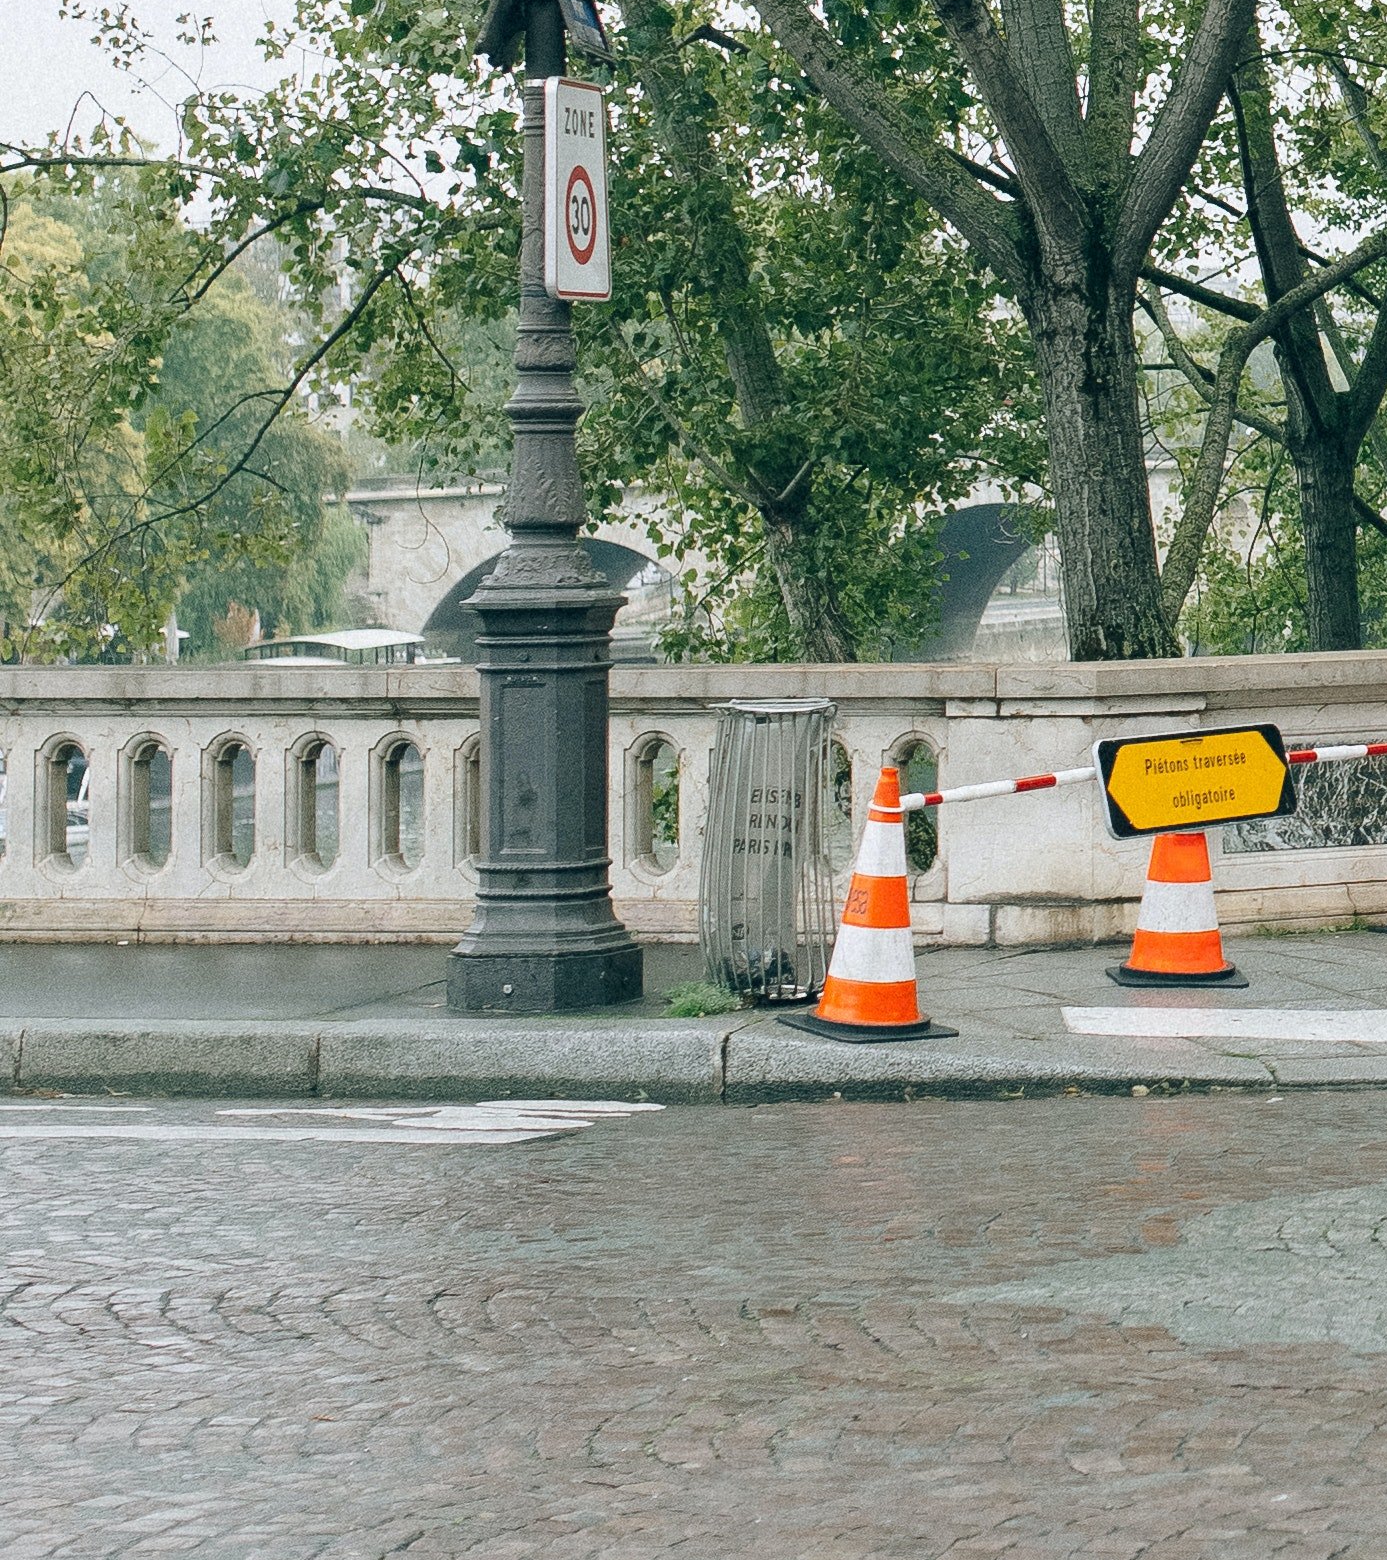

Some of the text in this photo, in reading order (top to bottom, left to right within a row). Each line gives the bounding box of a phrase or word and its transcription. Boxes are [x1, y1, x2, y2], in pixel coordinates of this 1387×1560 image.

[563, 106, 595, 139] ZONE
[571, 194, 590, 237] 30
[1144, 748, 1246, 776] Piétons traversée
[1172, 786, 1235, 810] obligatoire
[732, 837, 771, 855] PARIS
